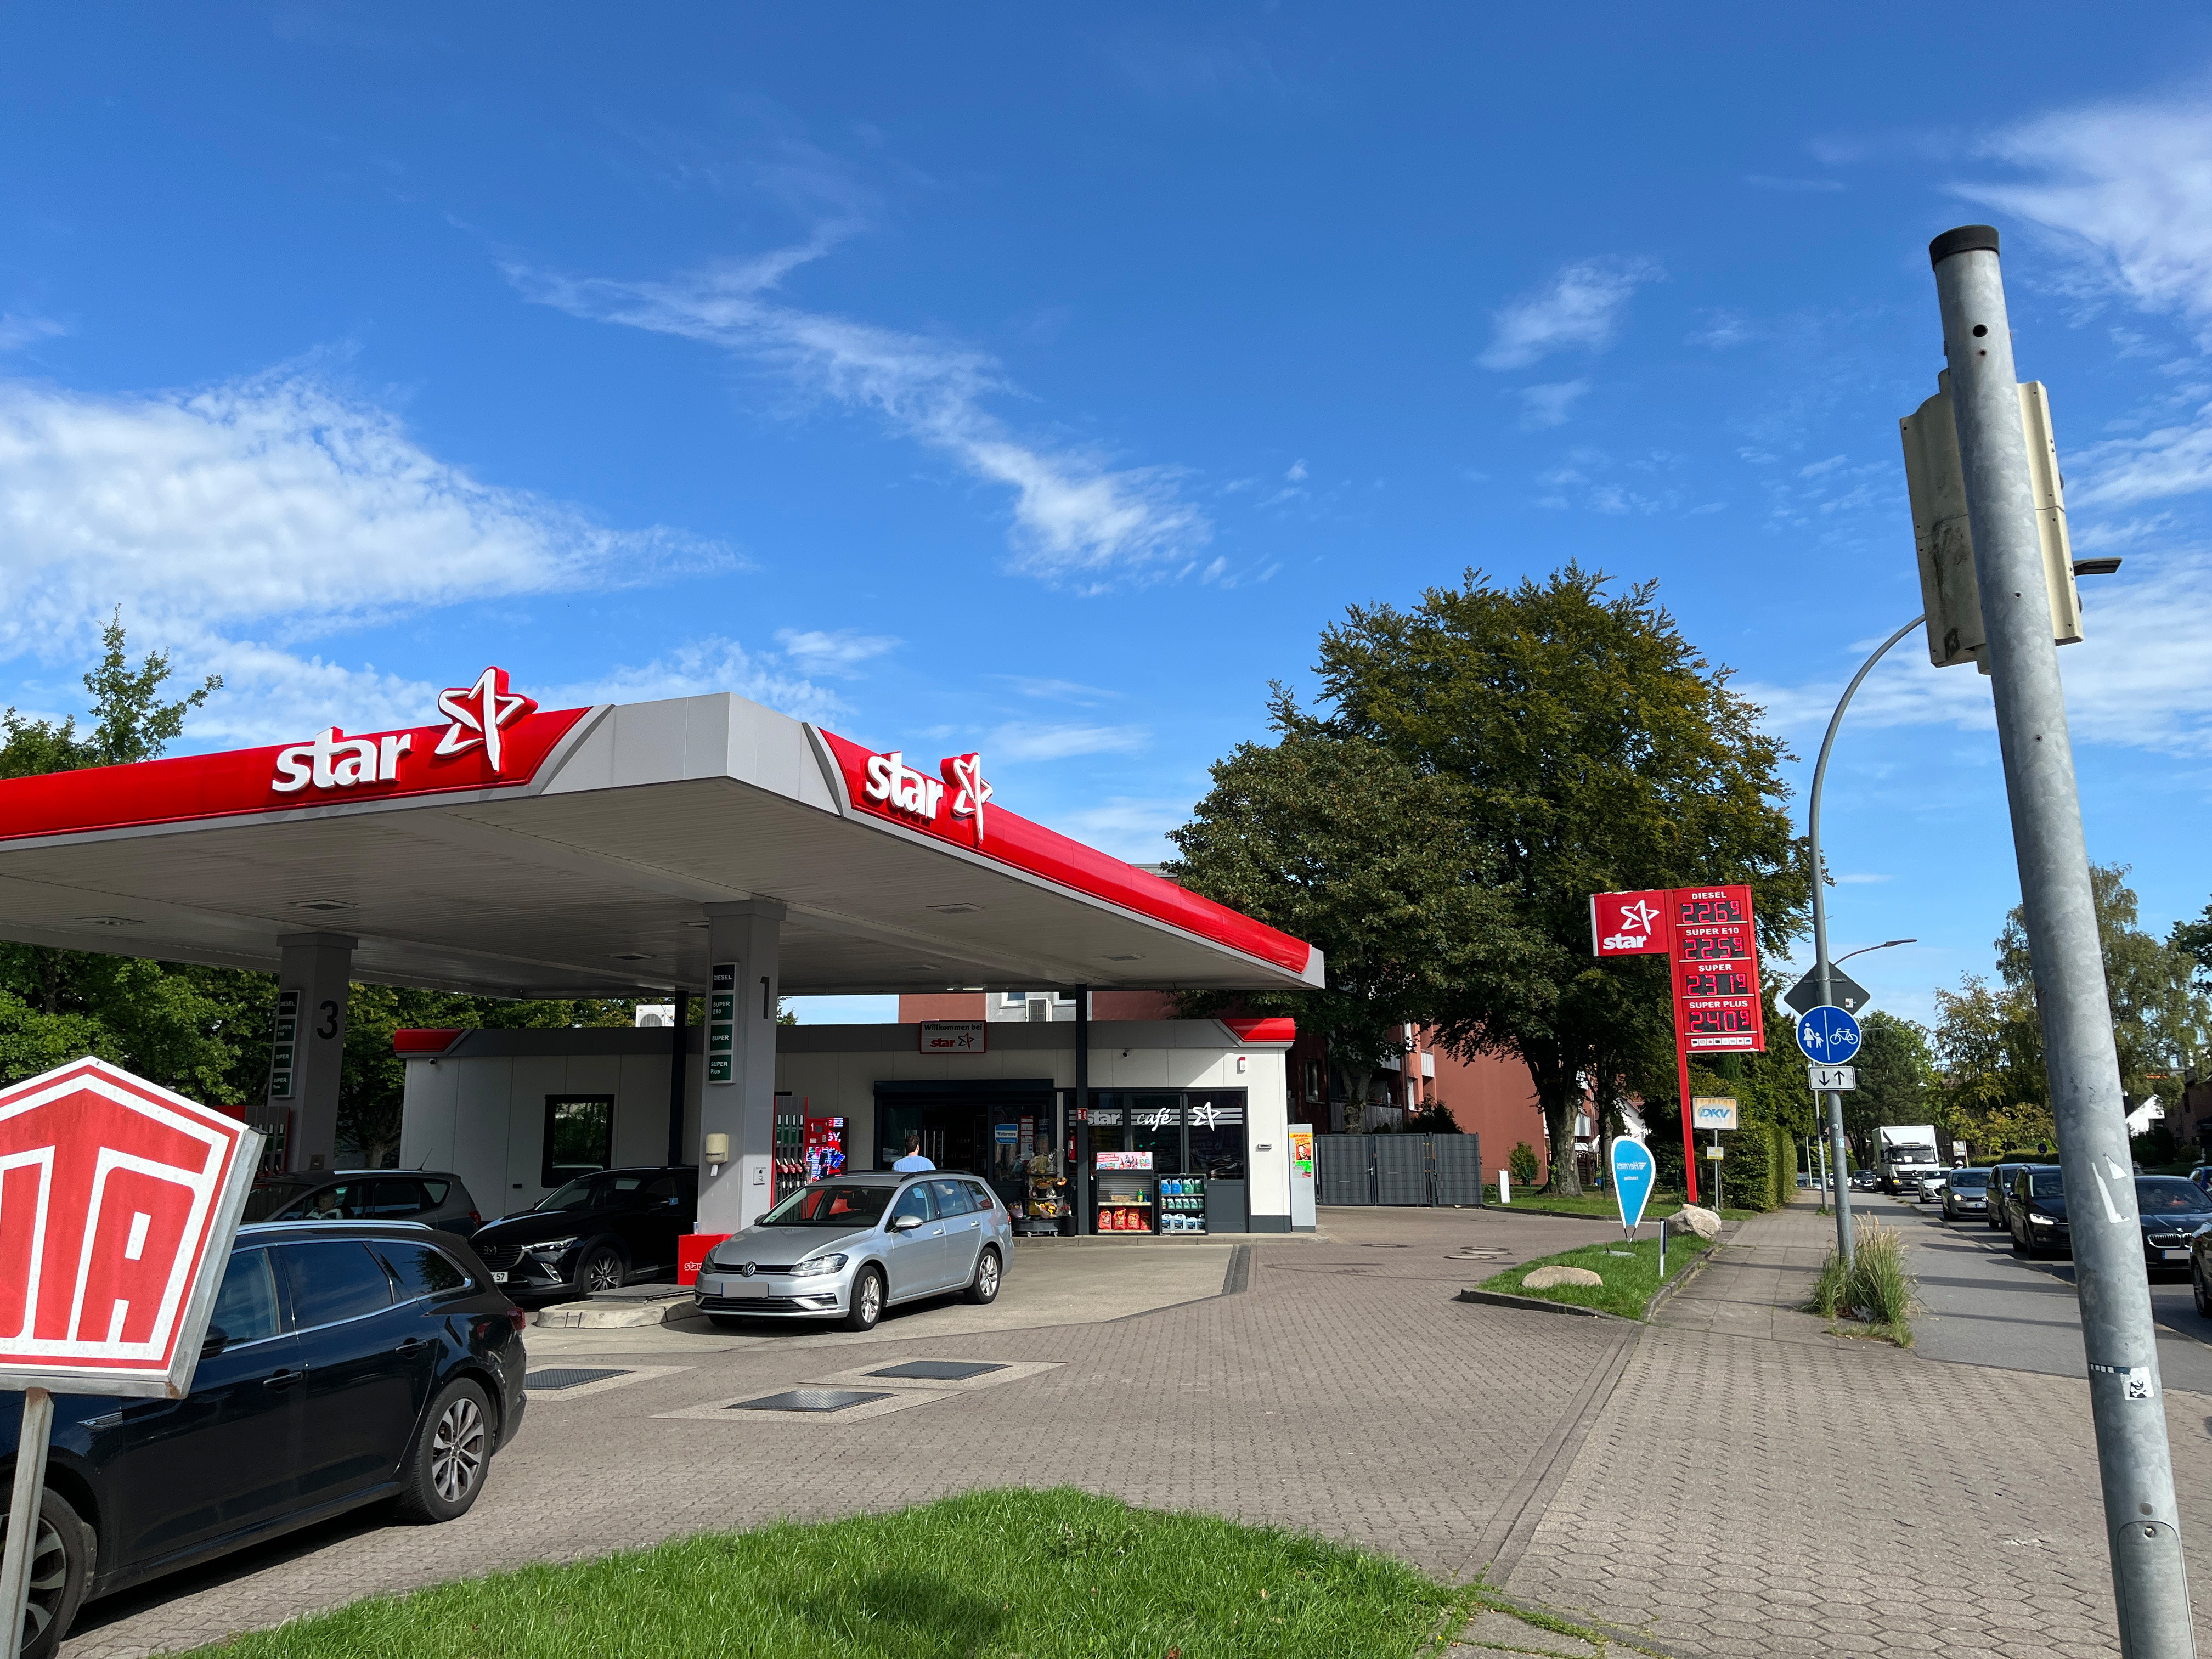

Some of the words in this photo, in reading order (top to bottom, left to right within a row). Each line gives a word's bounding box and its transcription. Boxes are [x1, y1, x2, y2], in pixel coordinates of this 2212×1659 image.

[272, 727, 411, 792] star
[866, 752, 943, 819] star
[1691, 891, 1727, 900] DIESEL
[1686, 928, 1719, 936] SUPER
[1602, 933, 1647, 950] star
[1699, 964, 1732, 972] SUPER
[760, 976, 770, 1019] 1
[317, 1000, 339, 1040] 3
[930, 1037, 956, 1047] star
[1700, 1108, 1730, 1118] DKV
[1087, 1110, 1120, 1125] star
[1136, 1107, 1173, 1132] café
[684, 1261, 703, 1271] star
[496, 1273, 505, 1281] 57
